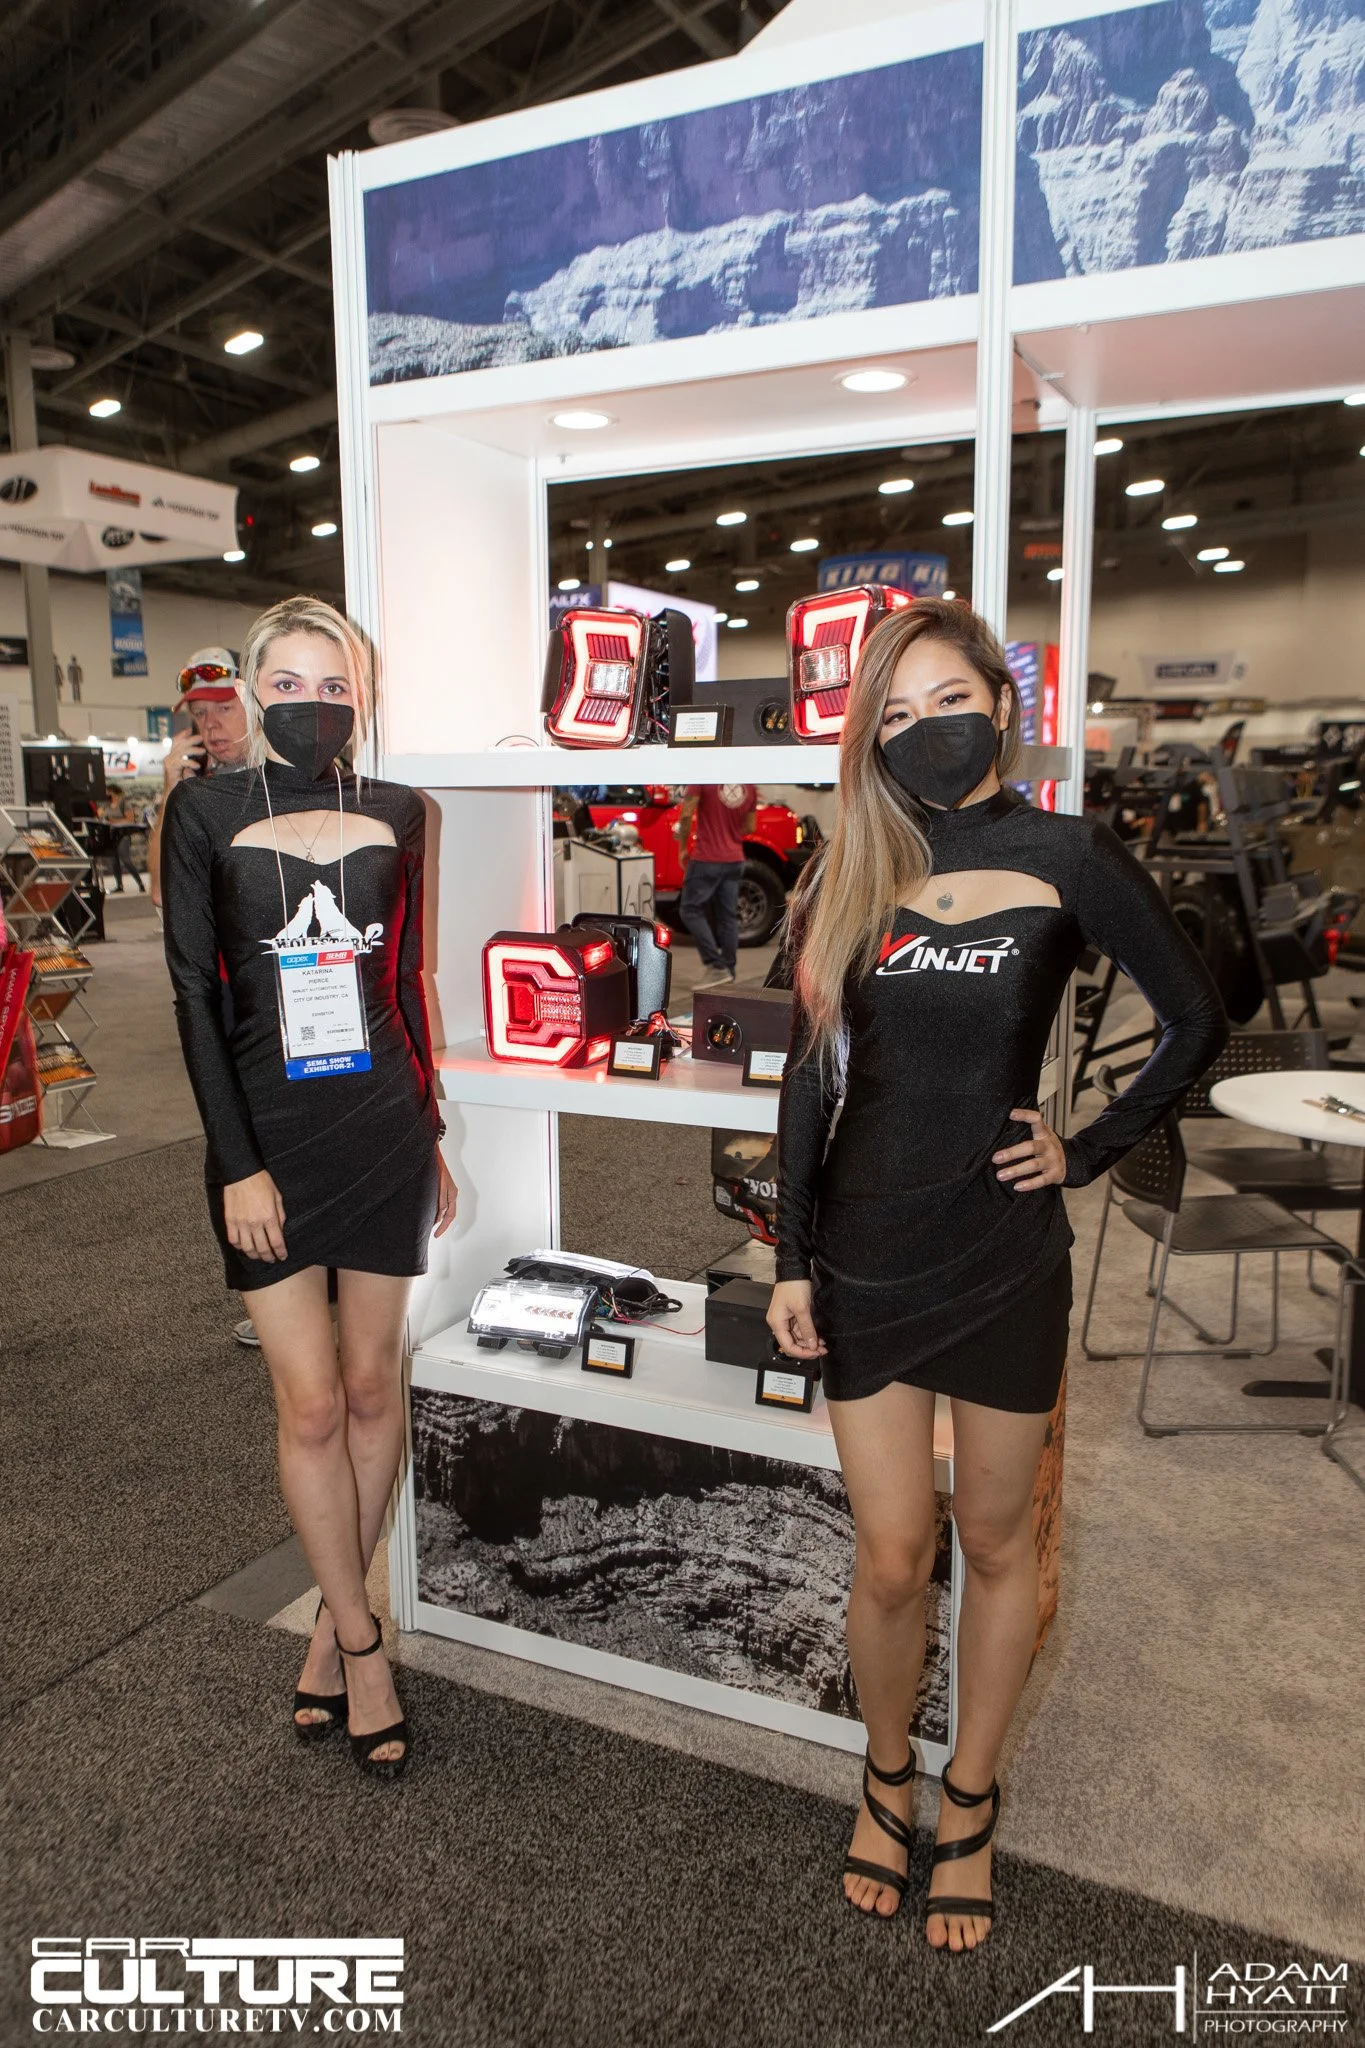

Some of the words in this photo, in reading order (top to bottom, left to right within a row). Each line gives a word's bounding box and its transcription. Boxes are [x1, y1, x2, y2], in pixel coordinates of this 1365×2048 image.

[876, 932, 1010, 975] WINJET
[302, 968, 333, 976] KATARINA
[309, 977, 329, 985] PIERCE
[303, 1062, 355, 1074] EXHIBITOR-21
[306, 1059, 328, 1068] SEMA
[329, 1056, 352, 1064] SHOW
